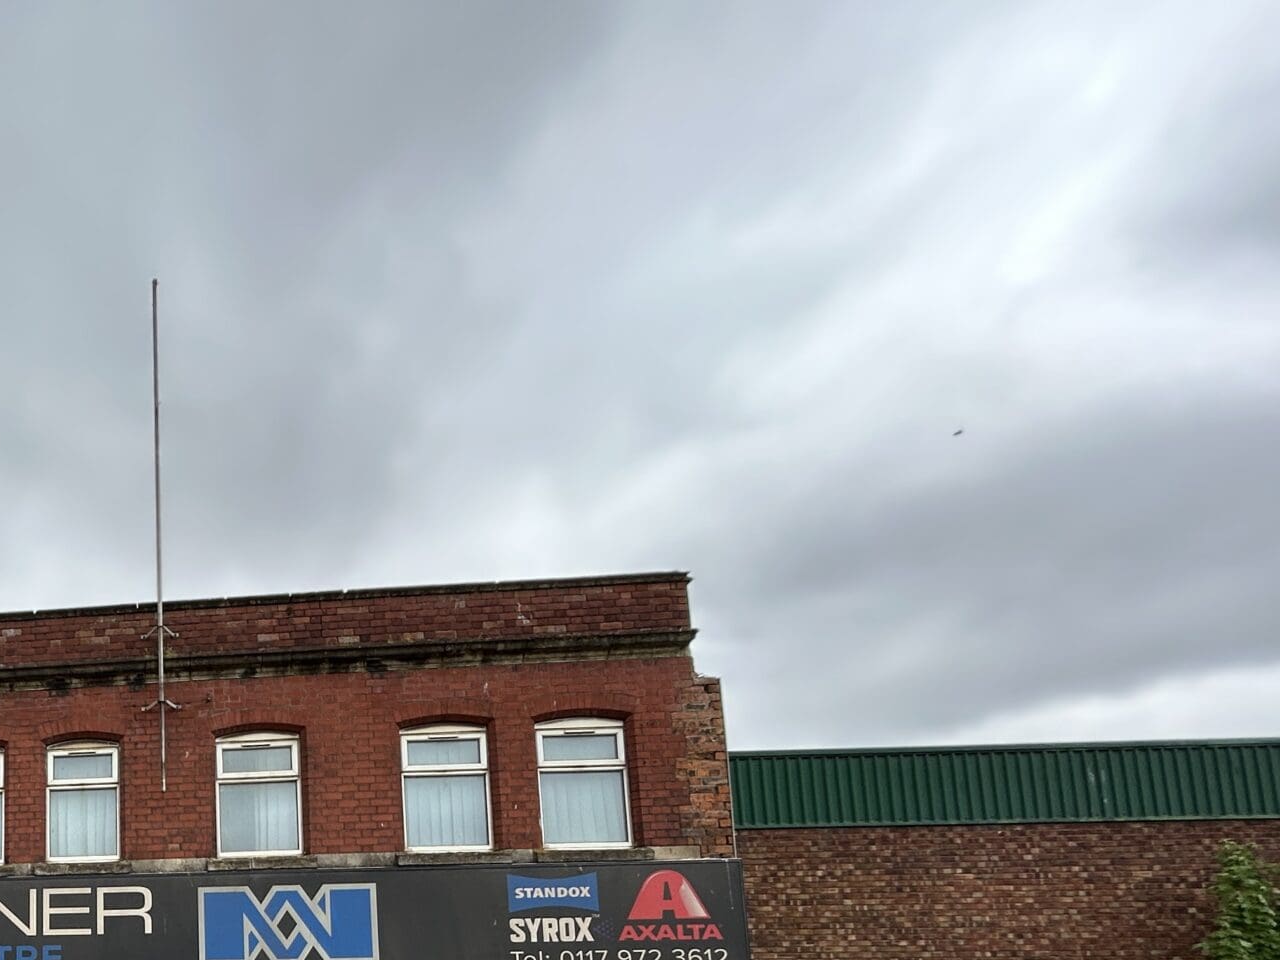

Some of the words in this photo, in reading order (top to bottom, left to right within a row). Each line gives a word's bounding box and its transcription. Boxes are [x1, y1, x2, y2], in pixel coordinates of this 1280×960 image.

[514, 886, 591, 899] STANDOX
[509, 917, 595, 942] SYROX
[619, 924, 723, 941] AXALTA
